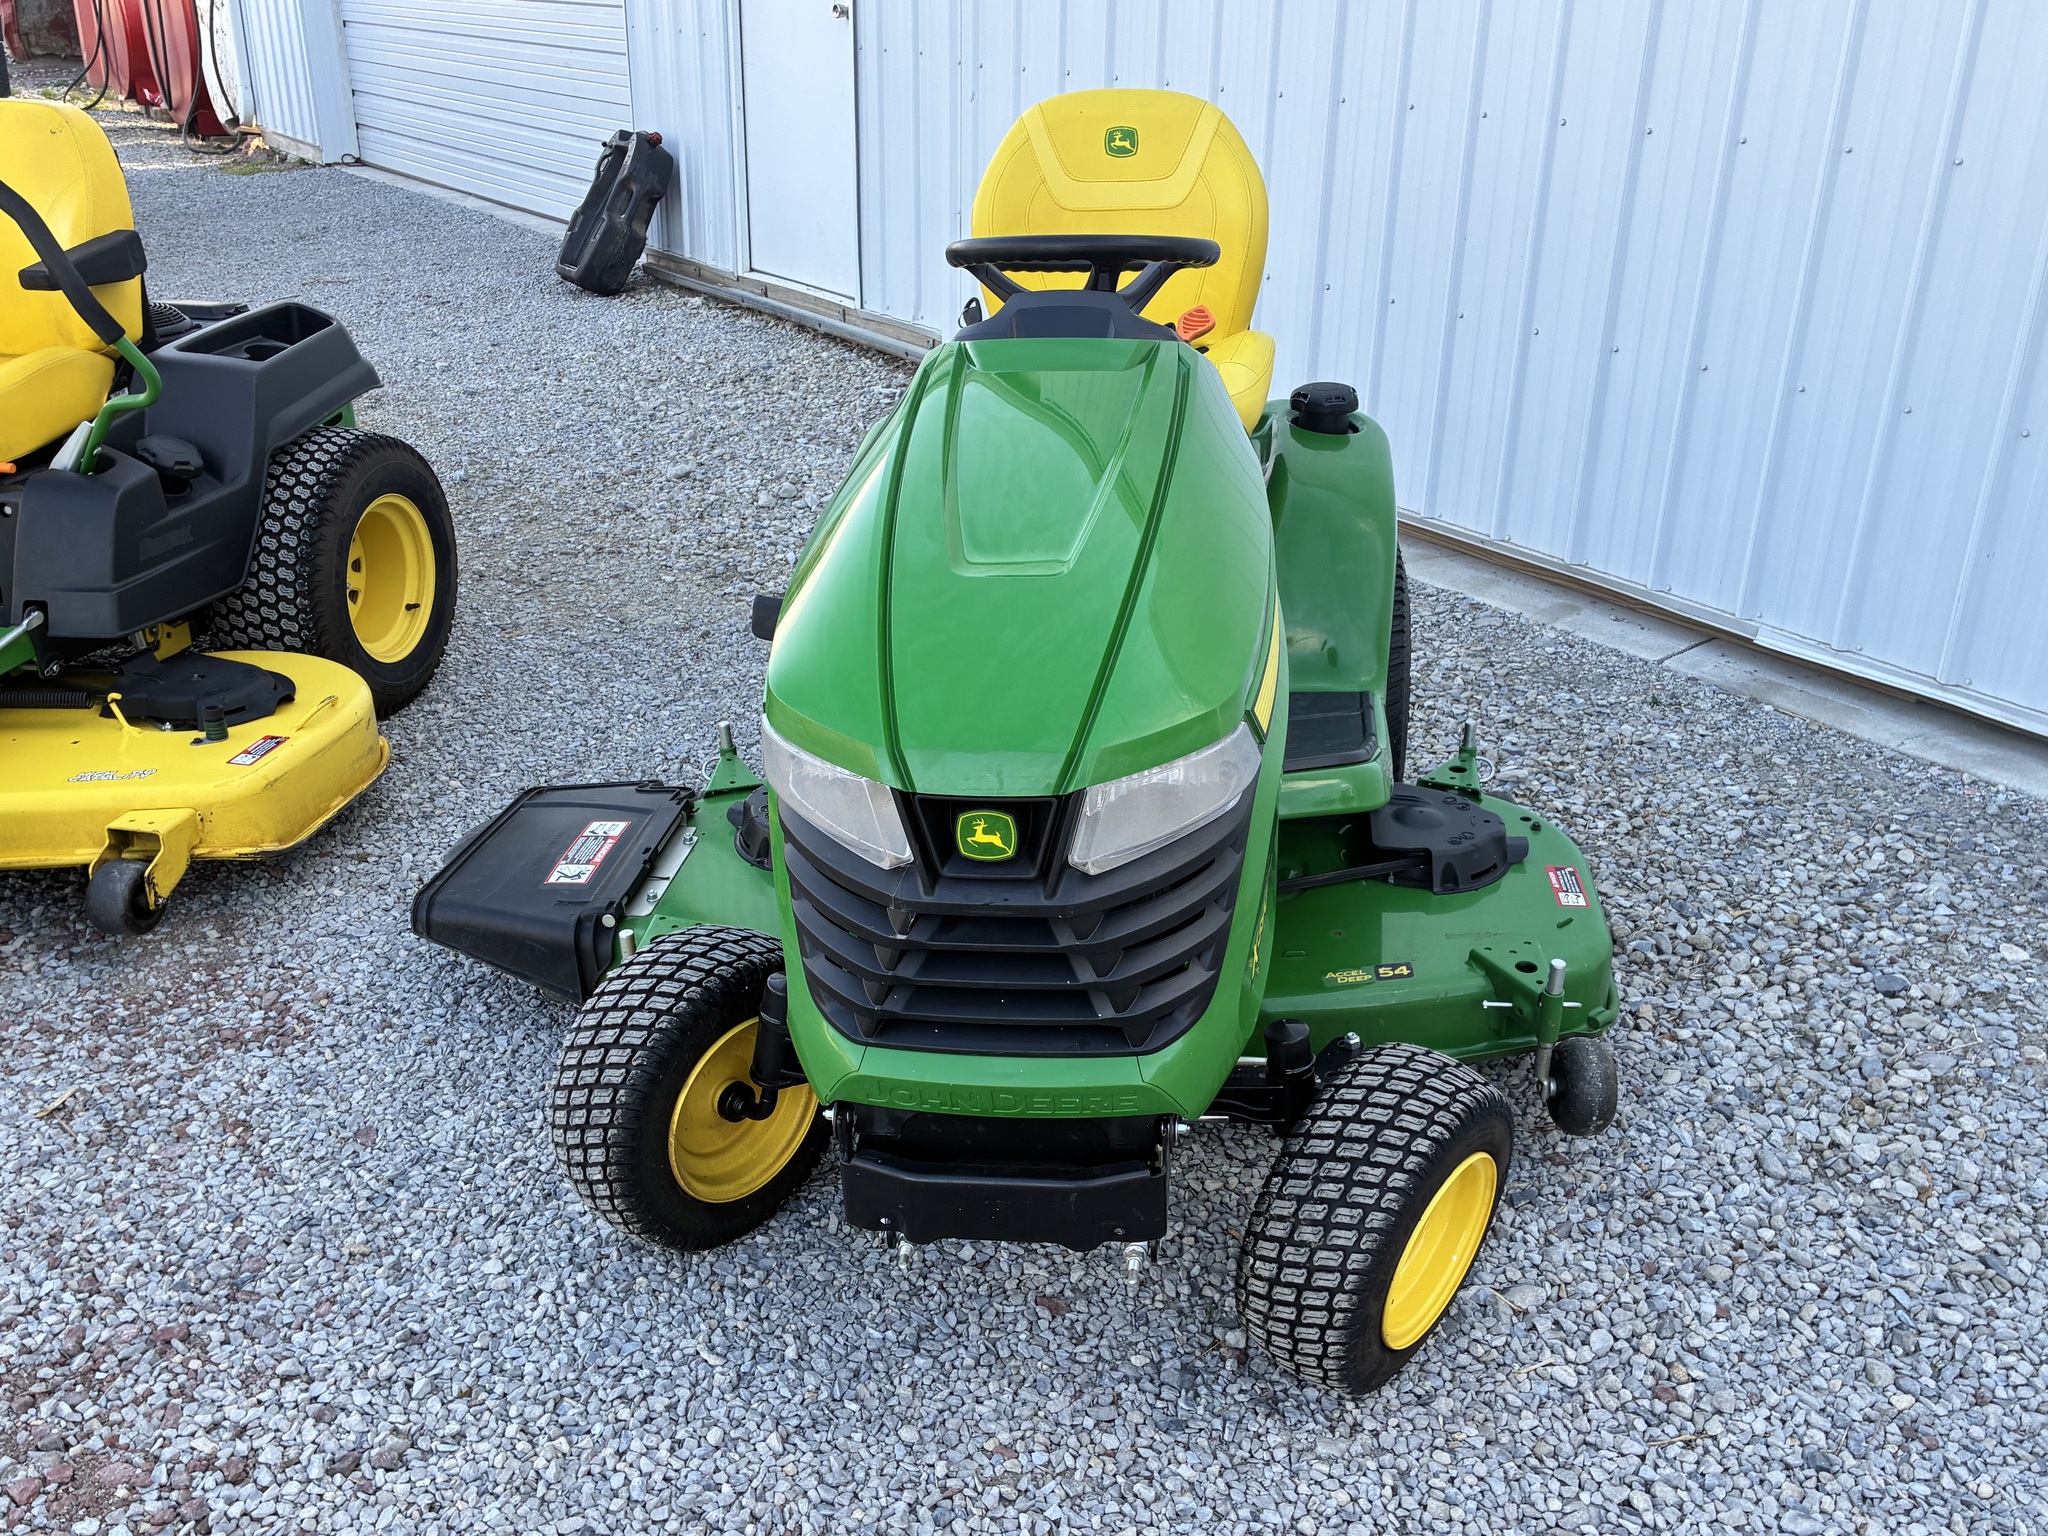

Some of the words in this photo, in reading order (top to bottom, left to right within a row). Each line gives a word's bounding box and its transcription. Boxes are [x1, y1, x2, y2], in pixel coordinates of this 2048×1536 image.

[1325, 970, 1367, 979] ACCEL
[1378, 965, 1411, 978] 54
[1337, 975, 1373, 984] DEEP
[866, 1080, 980, 1112] JOHN
[991, 1089, 1138, 1114] DEERE
